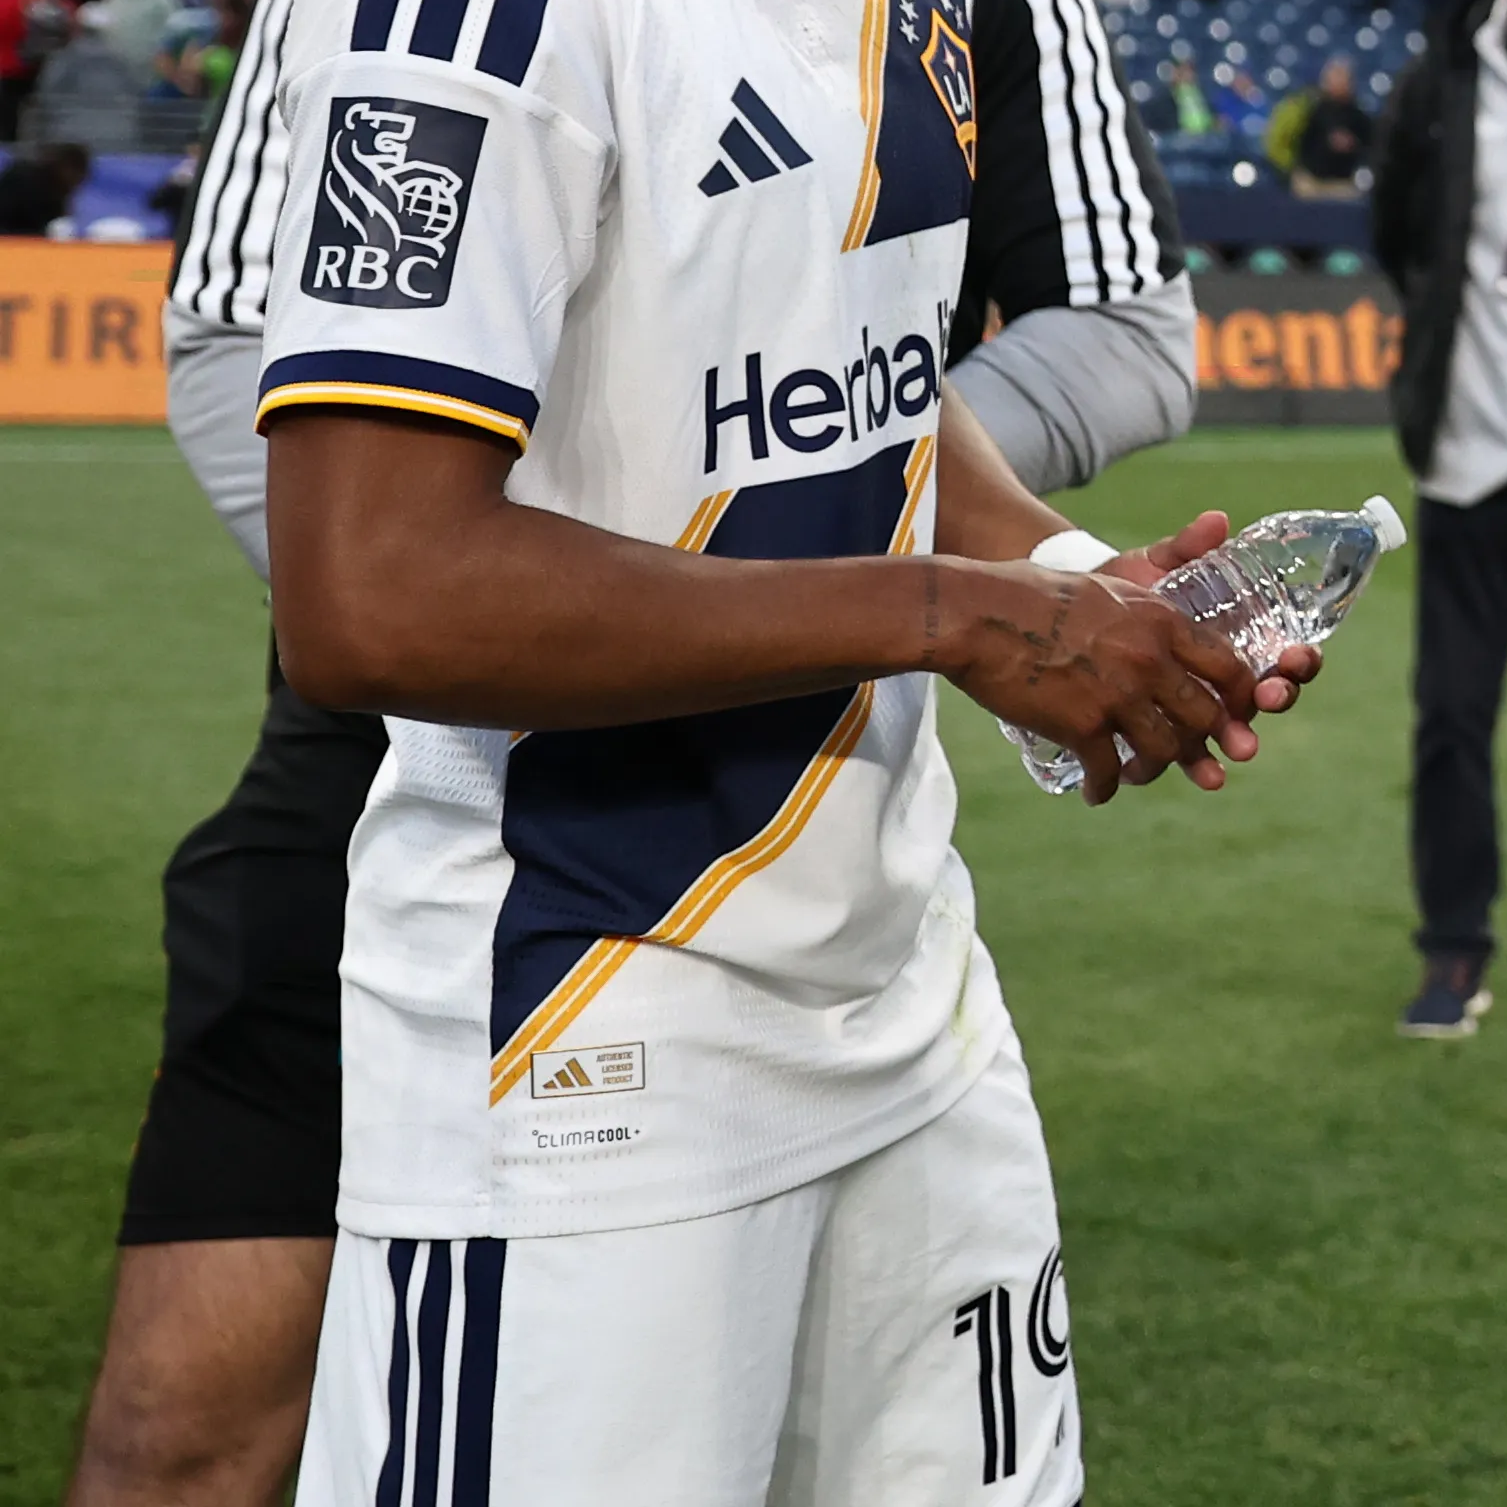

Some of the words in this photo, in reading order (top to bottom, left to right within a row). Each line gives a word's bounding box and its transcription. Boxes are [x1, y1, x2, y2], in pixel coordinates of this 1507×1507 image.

[312, 244, 440, 301] RBC
[0, 294, 166, 366] TIR
[953, 1243, 1068, 1486] 19
